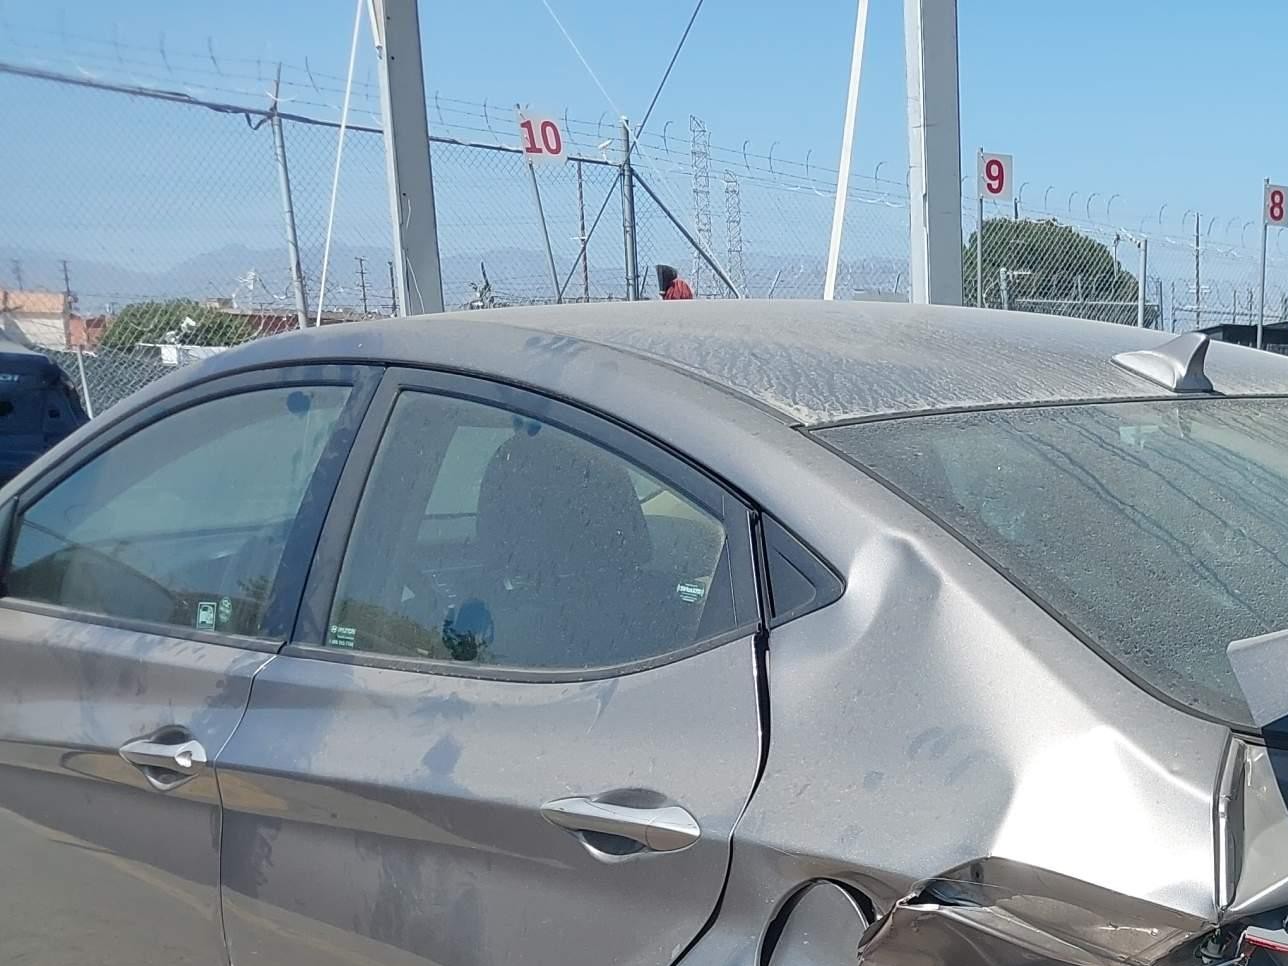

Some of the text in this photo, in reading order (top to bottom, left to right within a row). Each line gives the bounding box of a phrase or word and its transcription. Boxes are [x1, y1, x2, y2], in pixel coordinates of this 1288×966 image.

[520, 119, 562, 155] 10
[985, 159, 1005, 194] 9
[1269, 190, 1284, 221] 8
